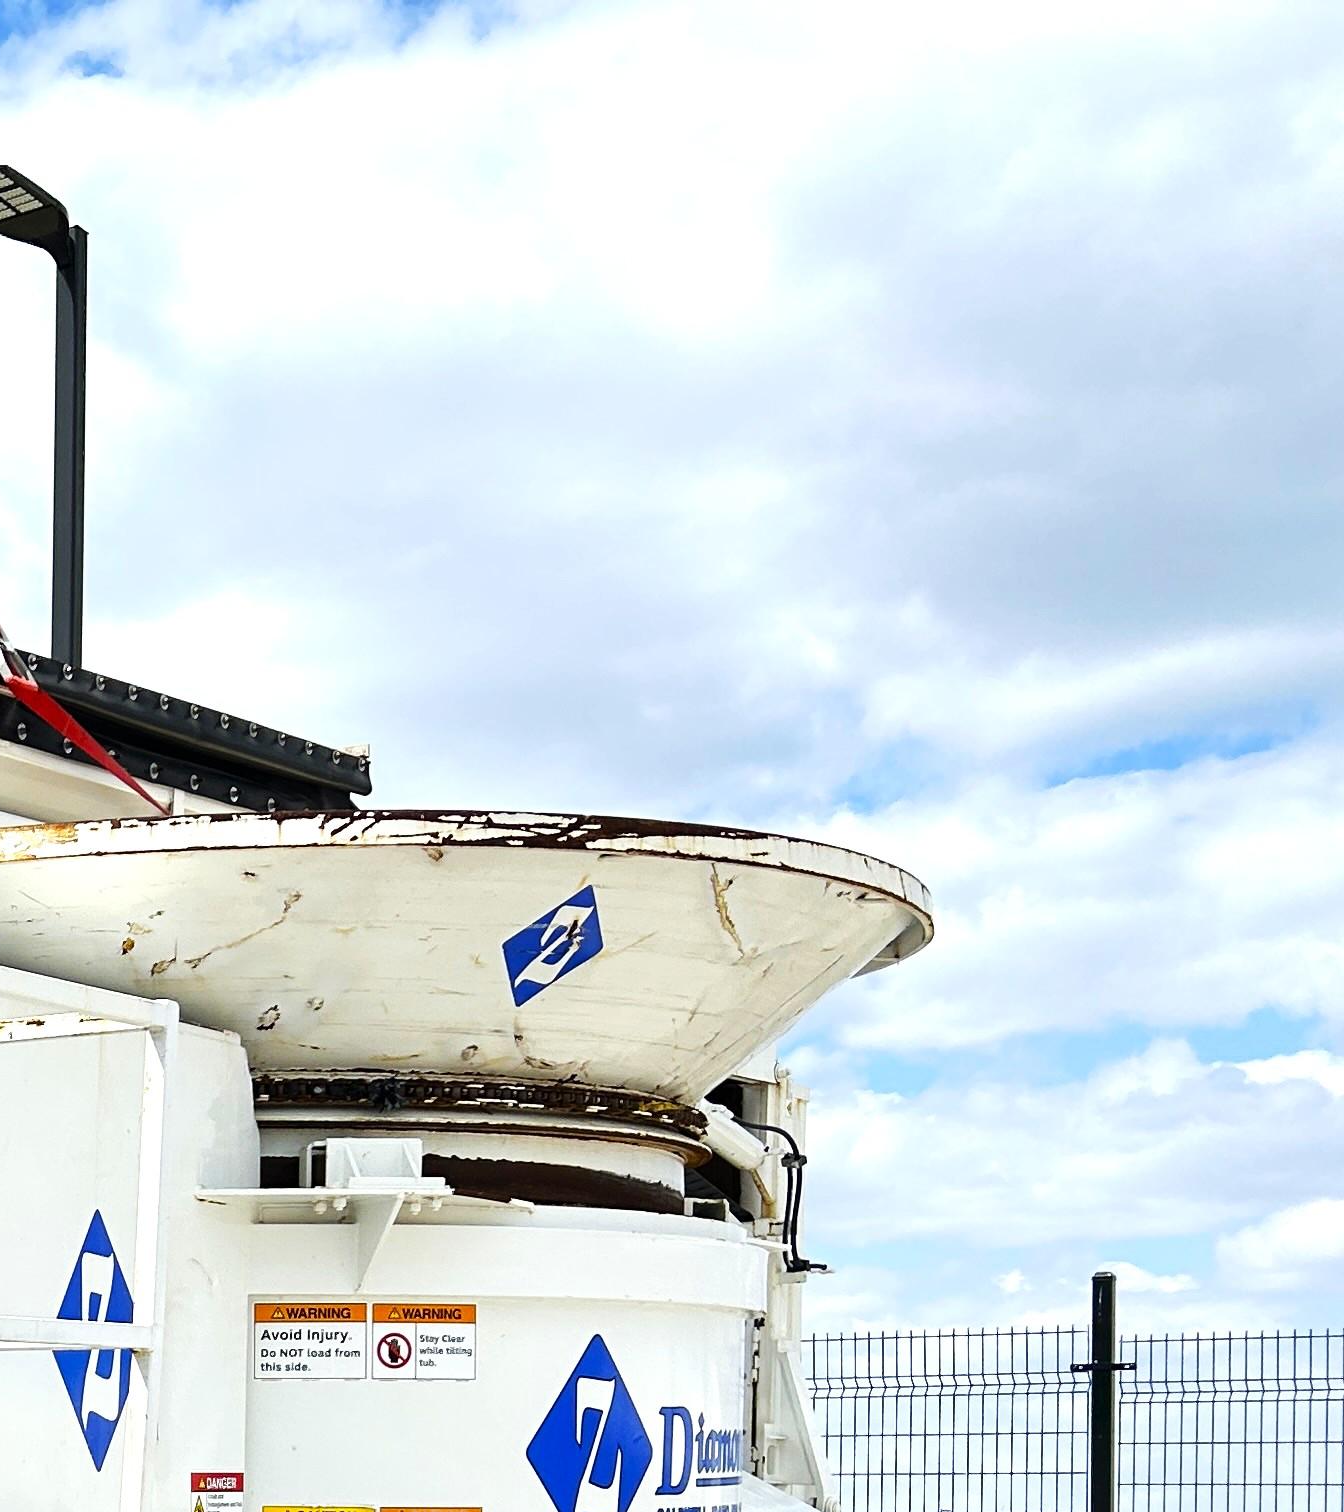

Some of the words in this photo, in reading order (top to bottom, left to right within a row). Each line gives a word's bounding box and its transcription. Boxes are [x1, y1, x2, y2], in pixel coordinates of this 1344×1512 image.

[286, 1307, 351, 1319] WARNING
[402, 1308, 461, 1320] WARNING
[261, 1329, 302, 1341] Avoid
[307, 1329, 352, 1343] Injury.
[419, 1335, 439, 1344] Stay
[261, 1349, 276, 1357] Do
[280, 1349, 304, 1357] NOT
[307, 1348, 332, 1357] load
[335, 1348, 361, 1357] from
[261, 1362, 281, 1371] this
[285, 1362, 311, 1371] side.
[419, 1359, 437, 1367] tub.
[206, 1477, 237, 1489] DANGER
